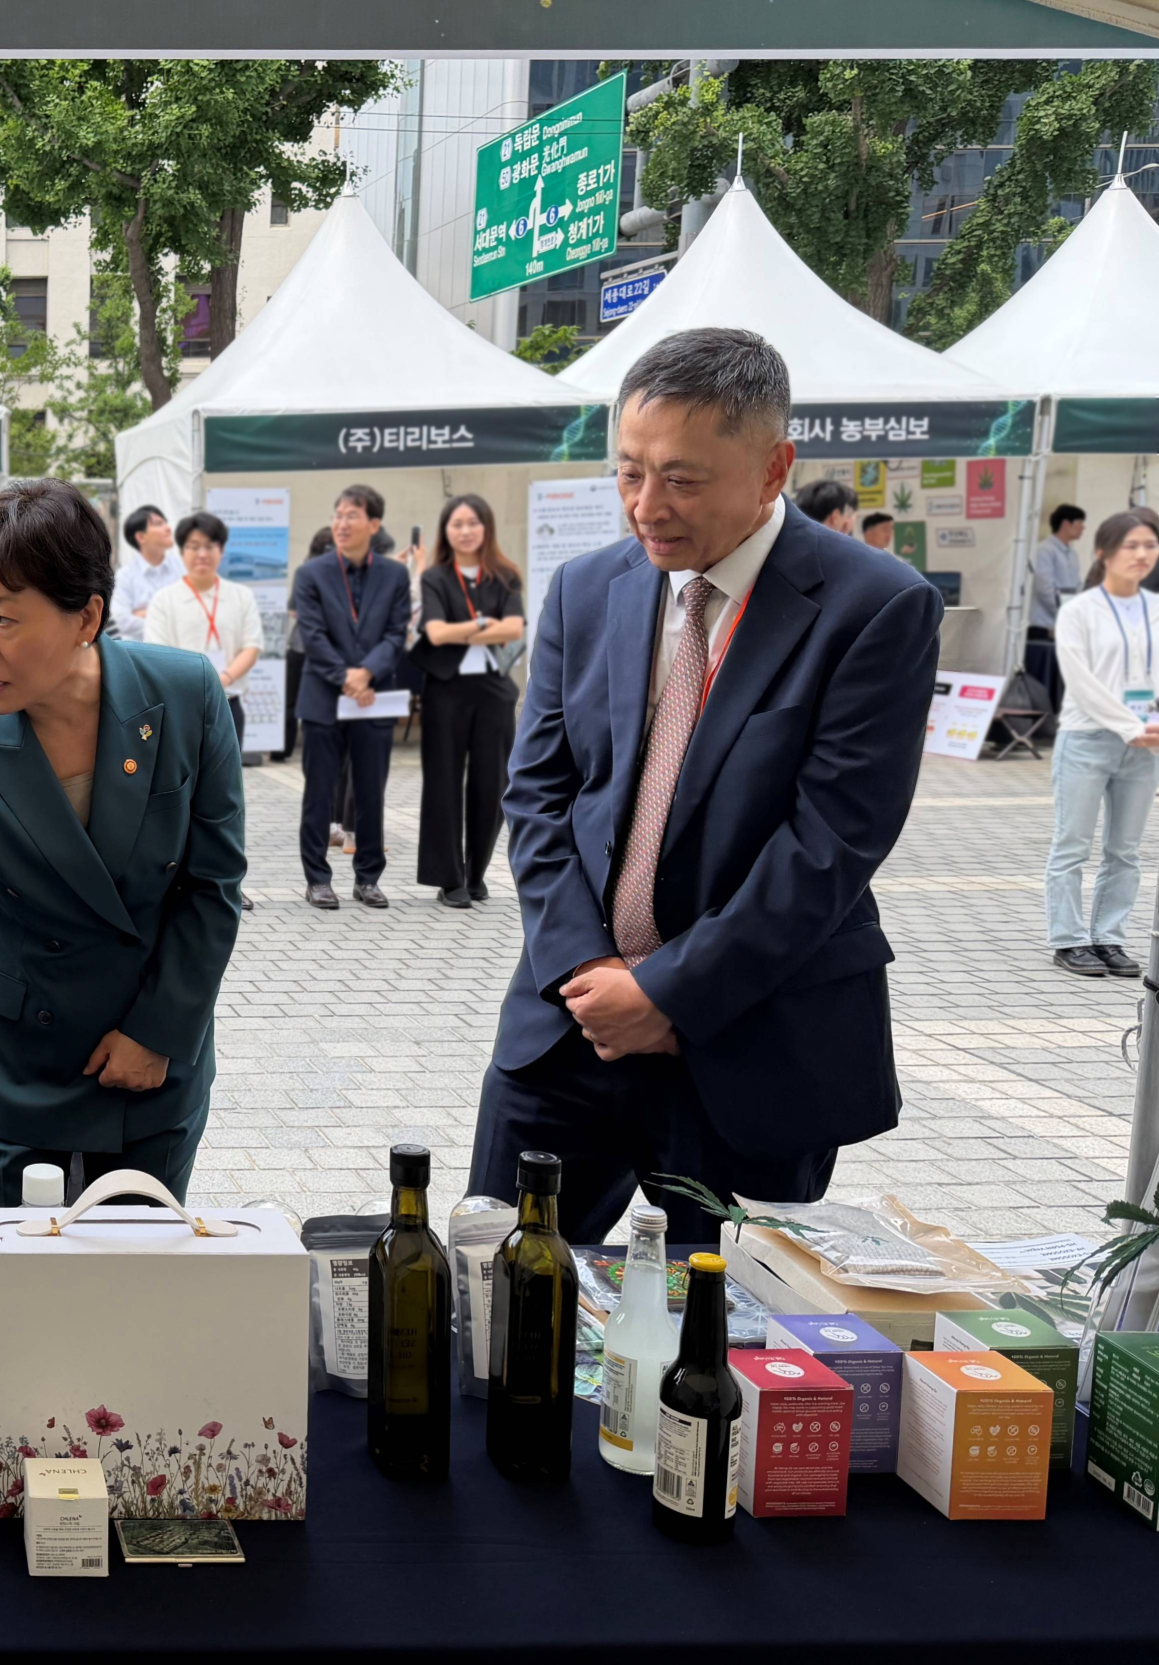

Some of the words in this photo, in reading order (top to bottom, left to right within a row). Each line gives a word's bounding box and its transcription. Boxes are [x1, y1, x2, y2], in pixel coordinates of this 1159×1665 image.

[514, 123, 540, 153] 독립문
[542, 136, 567, 163] 光化門
[512, 153, 539, 184] 광화문
[541, 147, 588, 177] Gwanghwamun
[577, 160, 615, 195] 종로1가
[575, 197, 595, 213] Jongno
[474, 221, 507, 251] 서대문역
[567, 211, 604, 244] 청계1가
[525, 260, 544, 276] 140m
[604, 279, 650, 304] 세종대로22길
[338, 424, 475, 454] (주)티리보스
[839, 416, 930, 442] 농부심보
